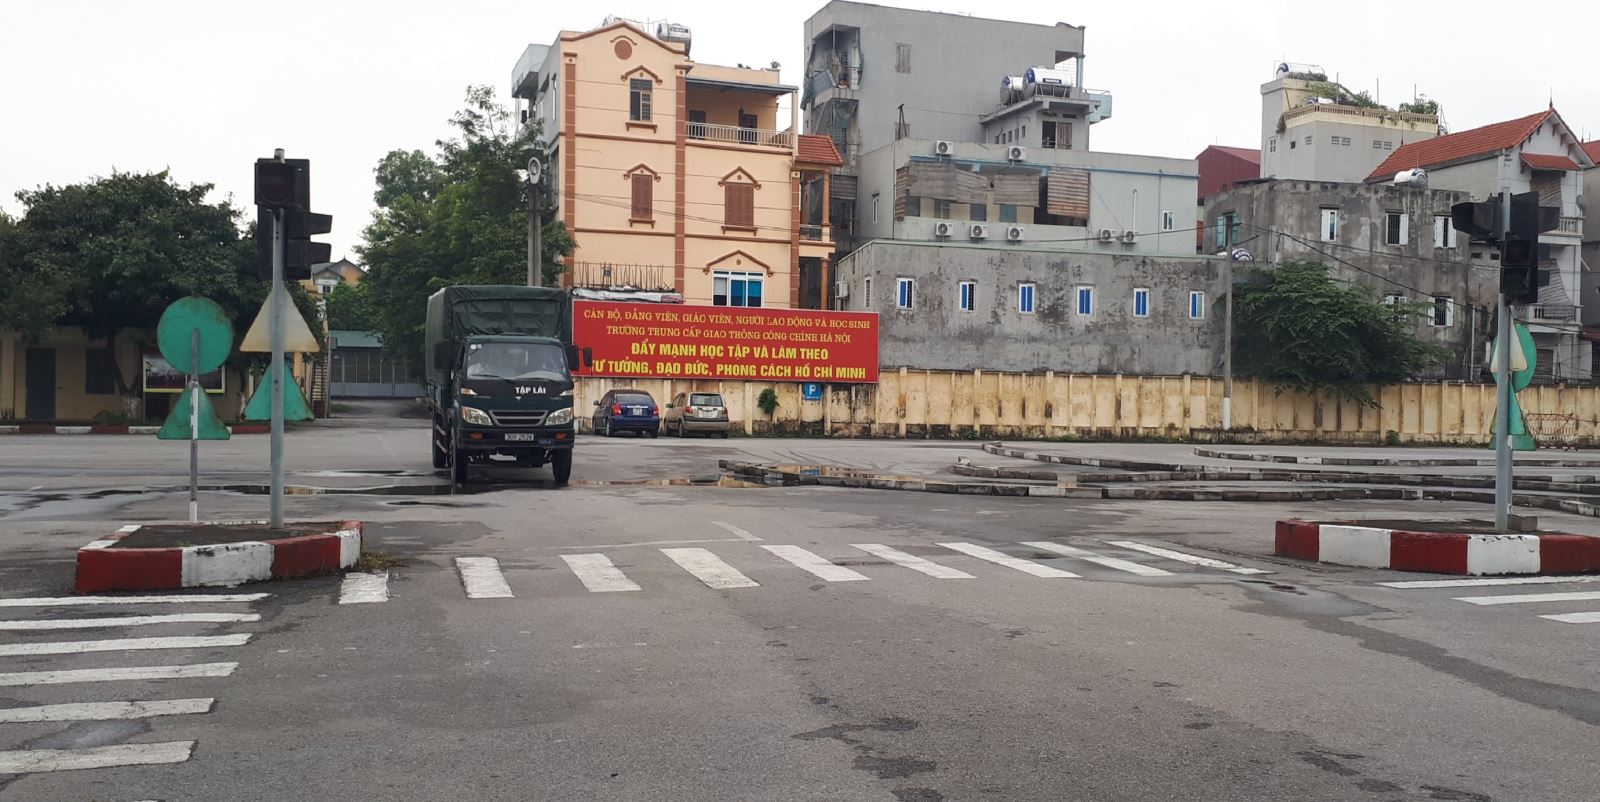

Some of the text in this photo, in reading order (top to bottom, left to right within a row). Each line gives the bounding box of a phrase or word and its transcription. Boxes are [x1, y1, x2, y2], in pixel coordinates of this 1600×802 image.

[607, 308, 622, 321] BỘ,
[625, 307, 652, 320] ĐẢNG
[683, 310, 706, 323] GIÁO
[736, 314, 764, 325] NGƯỜI
[767, 317, 785, 326] LAO
[787, 316, 812, 328] ĐỘNG
[829, 319, 848, 330] HỌC
[848, 320, 871, 329] SINH
[606, 324, 645, 336] TRƯỜNG
[648, 327, 680, 337] TRUNG
[682, 325, 701, 337] CẤP
[704, 328, 727, 339] GIAO
[729, 328, 760, 340] THÔNG
[762, 329, 787, 340] CÔNG
[835, 333, 851, 344] NỘI
[631, 338, 828, 360] ĐẨY MẠNH HỌC TẬP VÀ LÀM THEO
[608, 356, 652, 375] TƯỞNG,
[656, 362, 681, 376] ĐẠO
[684, 360, 713, 376] ĐỨC,
[716, 363, 756, 377] PHONG
[760, 363, 791, 377] CÁCH
[813, 365, 832, 378] CHÍ
[836, 368, 866, 379] MINH
[515, 385, 531, 395] TẬP
[810, 385, 816, 395] P
